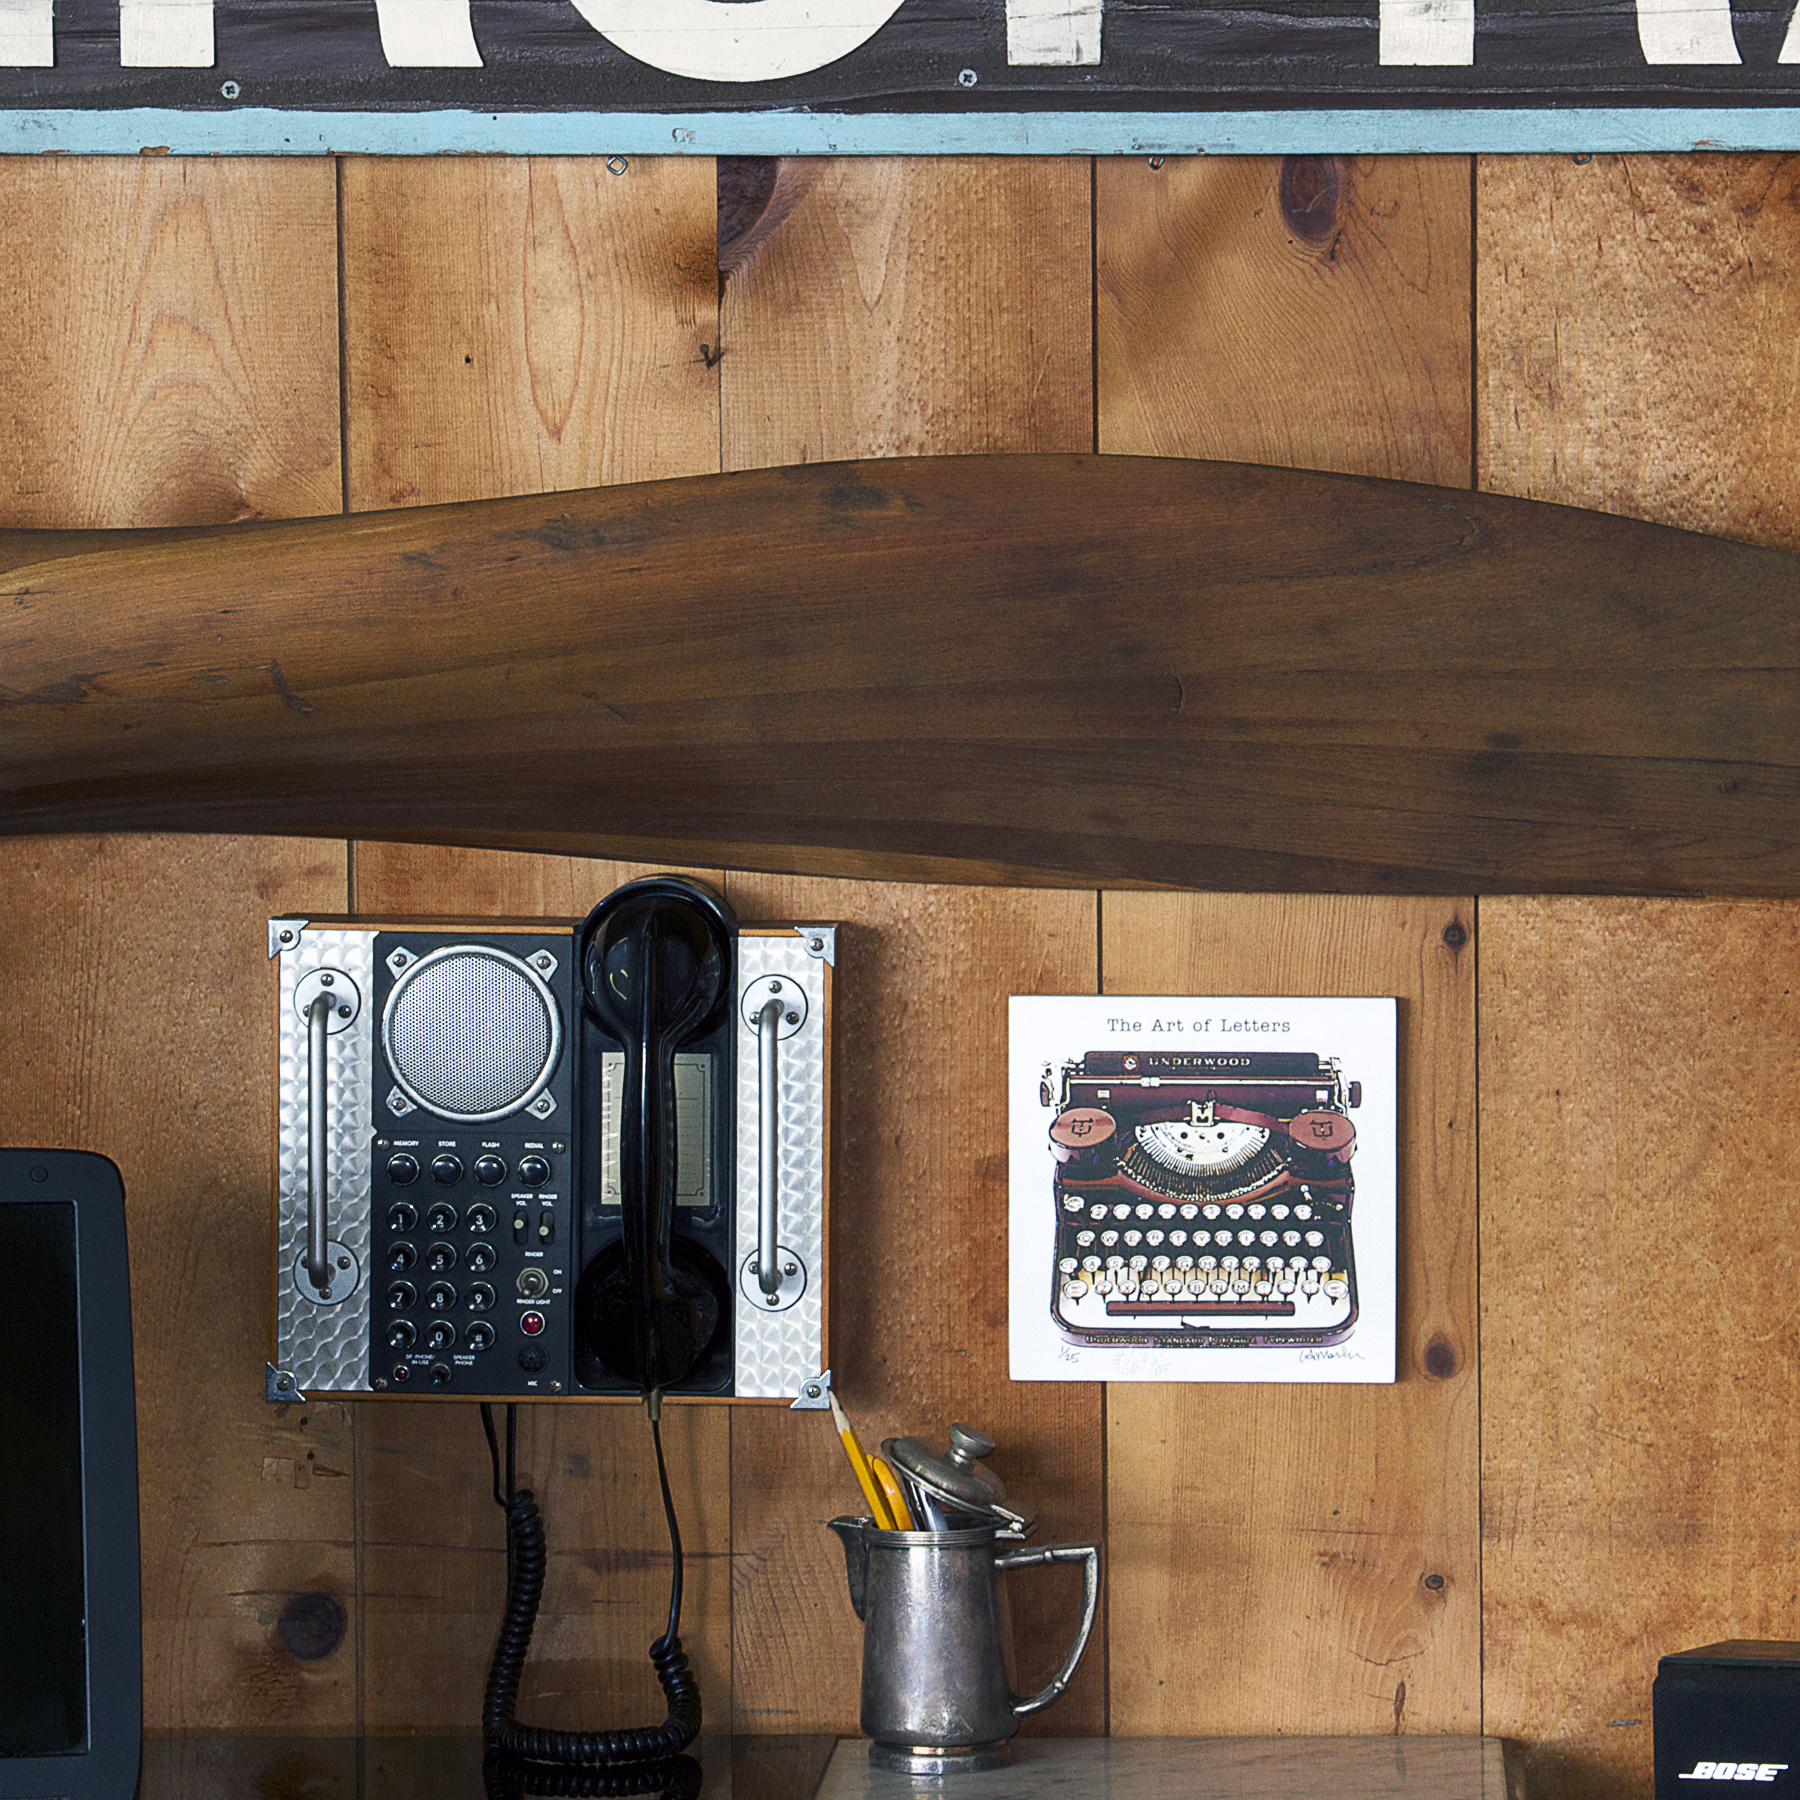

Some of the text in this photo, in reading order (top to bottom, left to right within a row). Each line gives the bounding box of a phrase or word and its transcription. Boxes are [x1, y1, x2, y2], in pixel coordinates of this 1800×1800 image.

[1107, 1018, 1291, 1033] The Art of Letters
[1149, 1057, 1251, 1067] UNDERWOOD
[437, 1140, 457, 1148] STORE
[481, 1141, 500, 1149] FLASH
[397, 1213, 484, 1225] 1 2 3
[396, 1253, 484, 1265] 4 5 6
[395, 1292, 483, 1304] 7 8 9
[435, 1331, 443, 1342] 0
[1058, 1346, 1080, 1363] 1/25
[1678, 1761, 1790, 1782] BOSE
